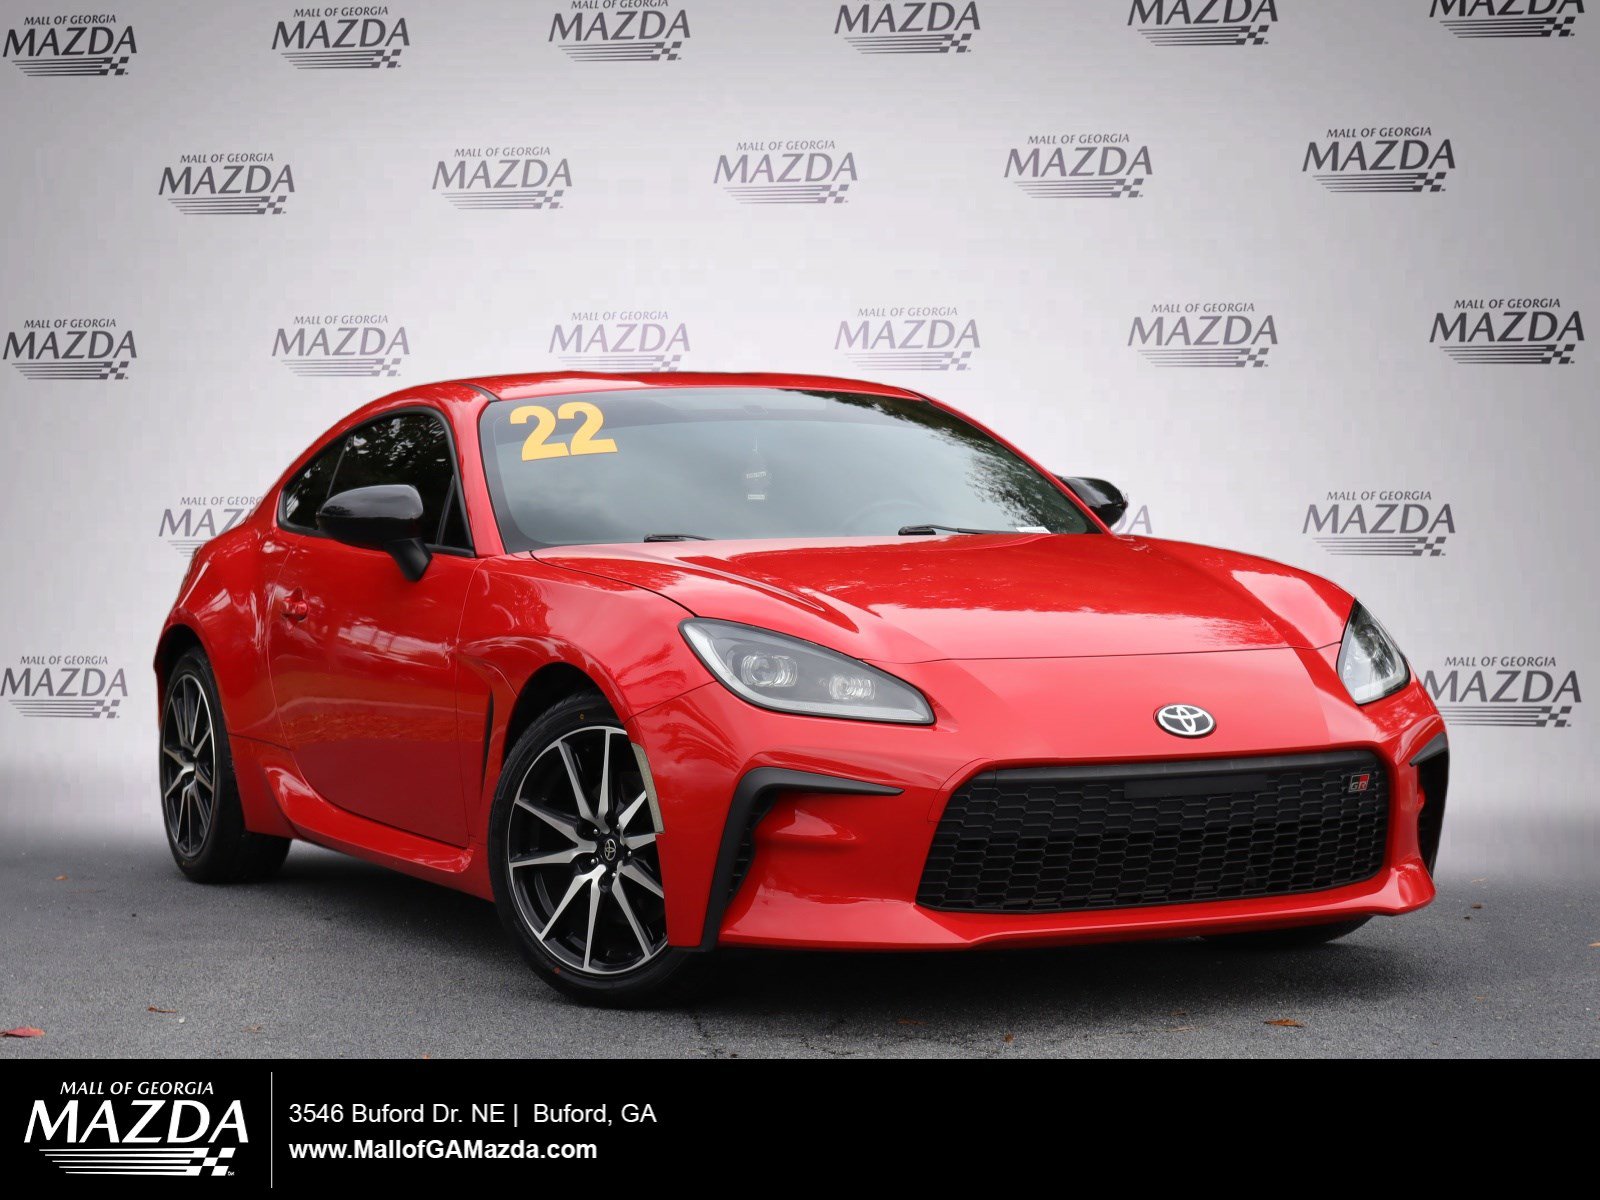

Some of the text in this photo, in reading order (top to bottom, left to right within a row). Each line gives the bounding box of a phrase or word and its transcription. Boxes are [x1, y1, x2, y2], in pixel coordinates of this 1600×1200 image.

[294, 5, 389, 18] MALL OF GEORGIA
[571, 0, 669, 10] MALL OF GEORGIA
[835, 1, 980, 35] MAZDA
[1127, 0, 1278, 26] MAZDA
[24, 14, 117, 26] MALL OF GEORGIA
[272, 18, 409, 51] MAZDA
[549, 10, 690, 43] MAZDA
[3, 26, 137, 58] MAZDA
[736, 139, 836, 152] MALL OF GEORGIA
[1028, 133, 1130, 145] MALL OF GEORGIA
[1326, 126, 1432, 139] MALL OF GEORGIA
[180, 152, 274, 164] MALL OF GEORGIA
[454, 146, 551, 158] MALL OF GEORGIA
[1004, 146, 1152, 178] MAZDA
[1303, 139, 1455, 172] MAZDA
[158, 165, 294, 196] MAZDA
[432, 158, 572, 191] MAZDA
[714, 152, 857, 184] MAZDA
[571, 310, 669, 322] MALL OF GEORGIA
[858, 306, 958, 318] MALL OF GEORGIA
[1151, 302, 1256, 314] MALL OF GEORGIA
[1454, 297, 1561, 310] MALL OF GEORGIA
[24, 318, 117, 329] MALL OF GEORGIA
[293, 314, 389, 326] MALL OF GEORGIA
[835, 318, 980, 350] MAZDA
[1128, 315, 1278, 347] MAZDA
[1430, 311, 1584, 343] MAZDA
[3, 331, 137, 361] MAZDA
[272, 326, 409, 357] MAZDA
[549, 323, 690, 354] MAZDA
[510, 401, 617, 461] 22
[227, 496, 263, 506] GEOR
[1326, 490, 1433, 502] MALL OF GEORGIA
[158, 508, 256, 537] MAZ
[1303, 503, 1455, 535] MAZDA
[20, 655, 108, 666] MALL OF GEORGIA
[1445, 655, 1557, 668] MALL OF GEORGIA
[0, 667, 128, 697] MAZDA
[1423, 670, 1582, 703] MAZDA
